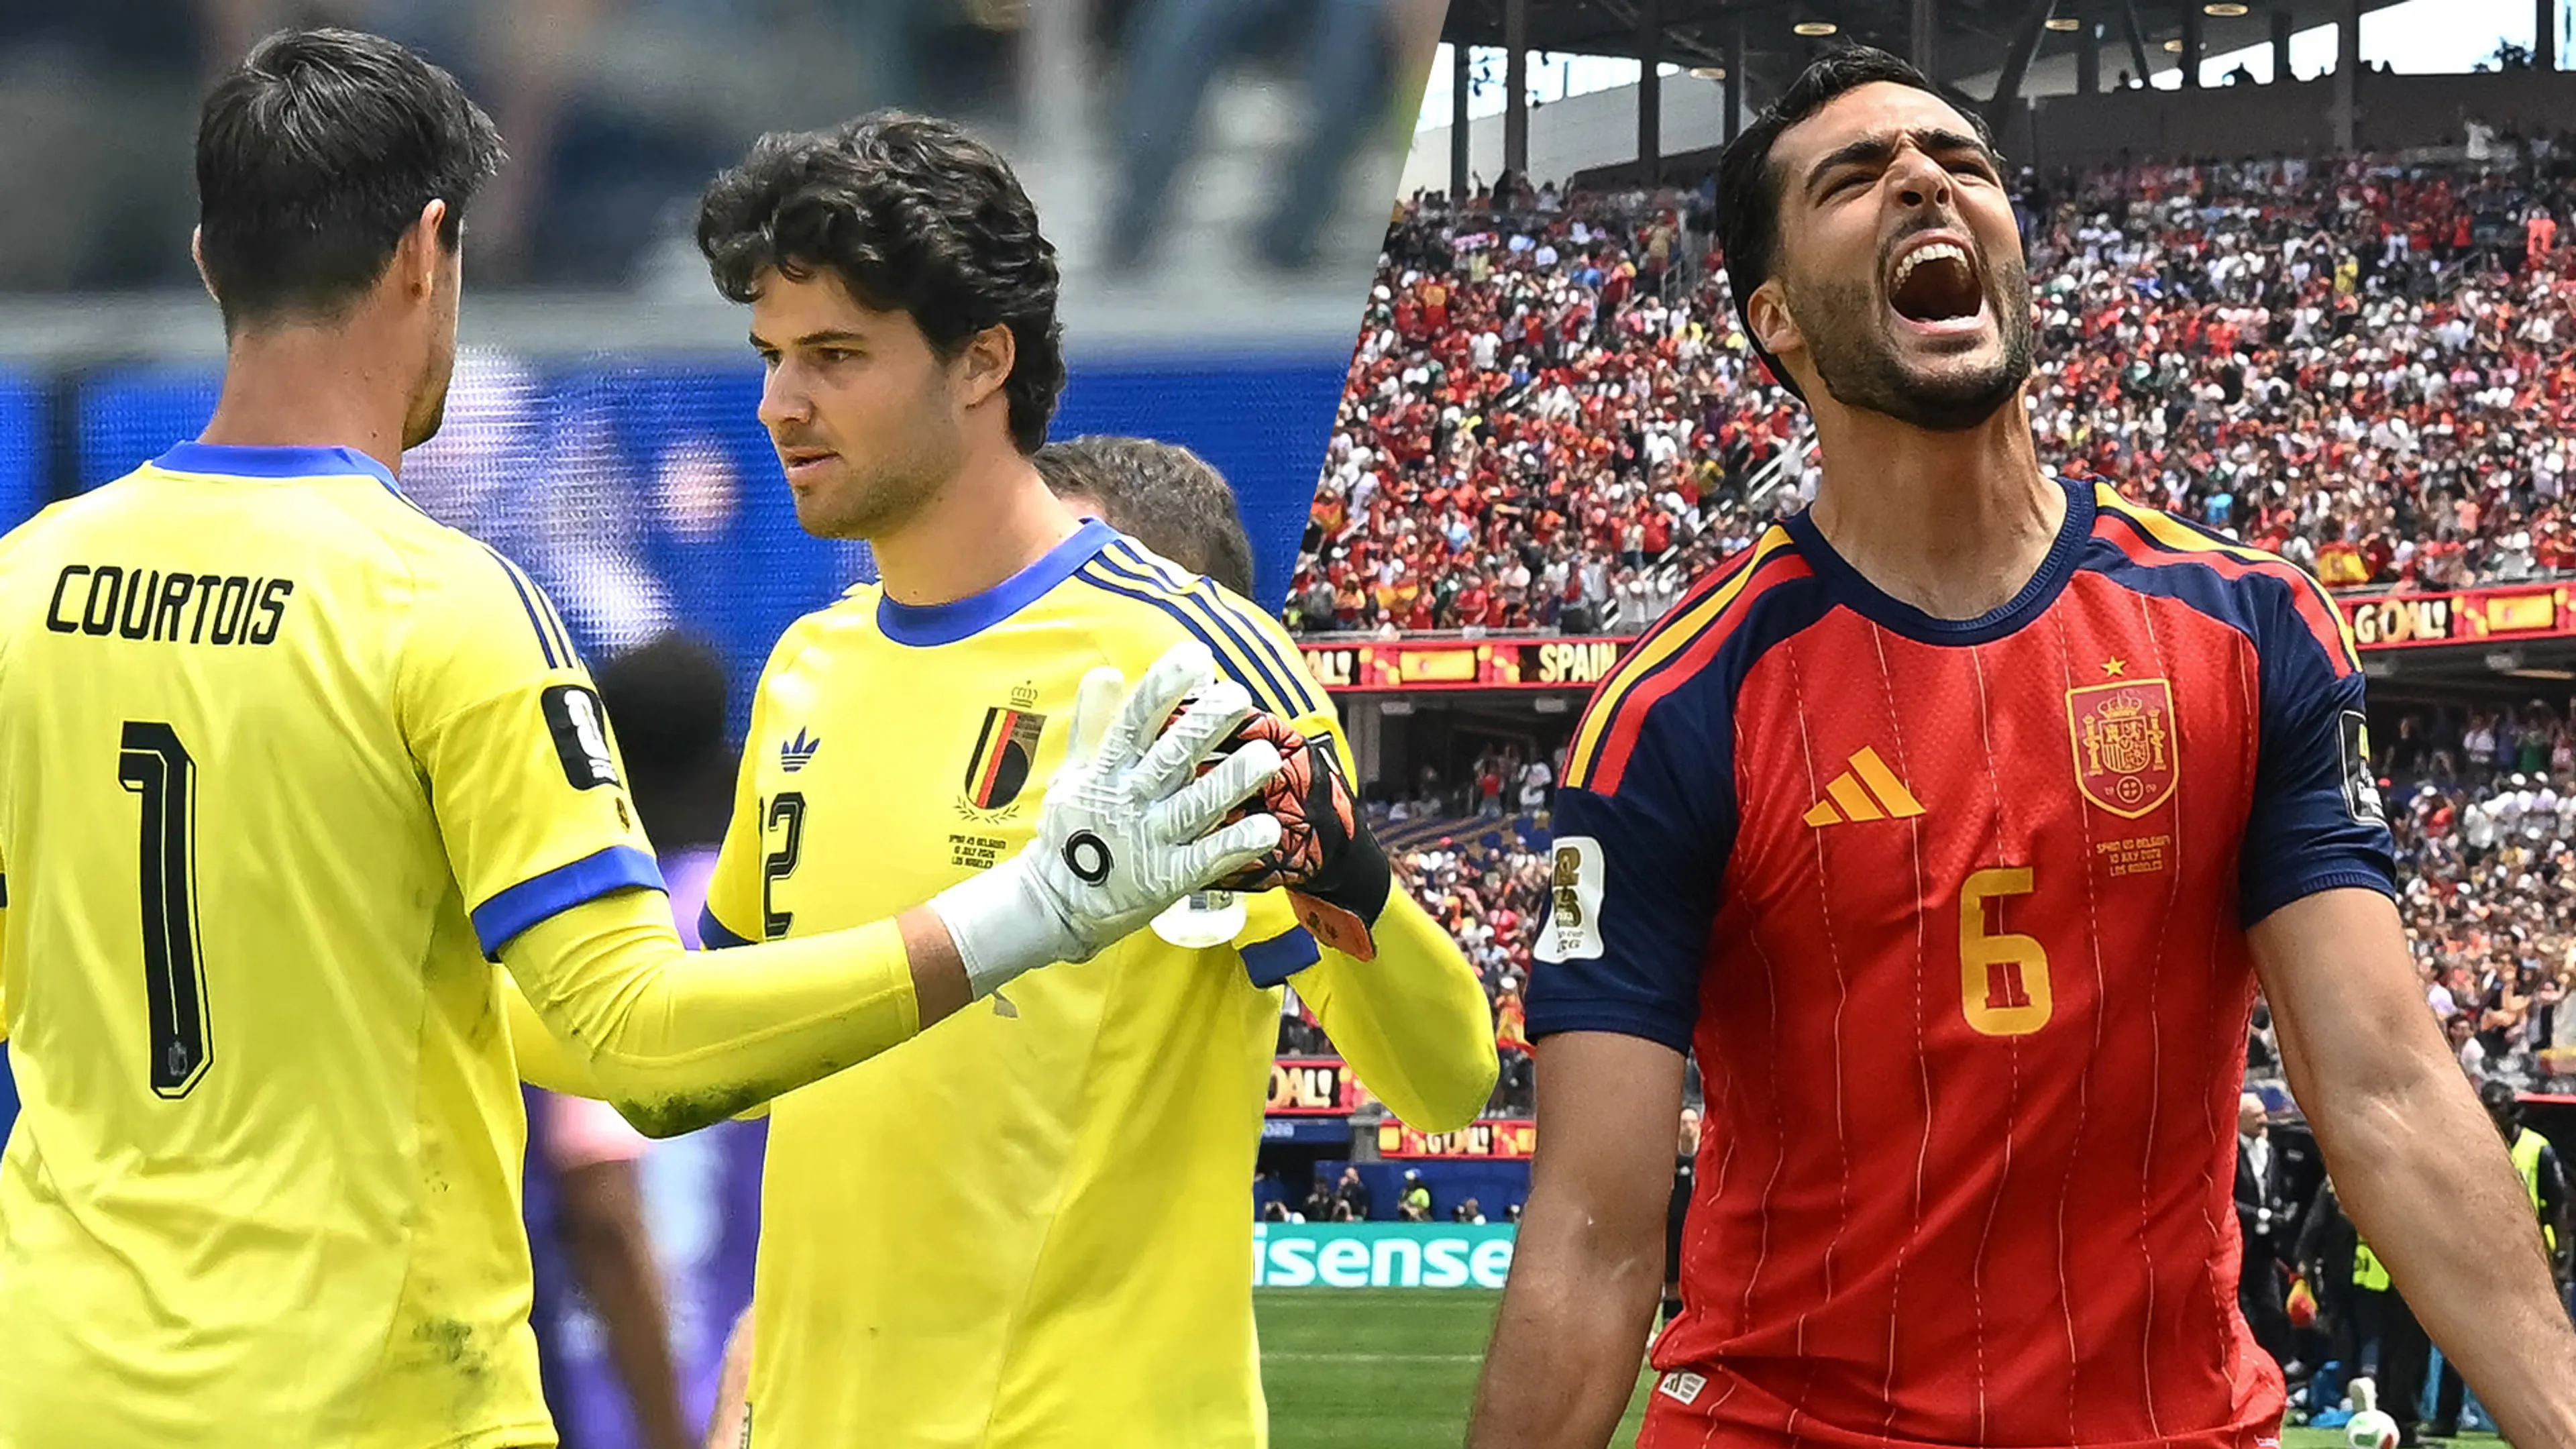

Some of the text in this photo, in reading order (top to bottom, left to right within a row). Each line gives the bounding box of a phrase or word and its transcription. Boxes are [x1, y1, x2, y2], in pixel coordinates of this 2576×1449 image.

[46, 564, 294, 646] COURTOIS
[2355, 599, 2447, 643] GOAL!
[1539, 642, 1617, 683] SPAIN
[759, 791, 807, 943] 2
[118, 720, 214, 1100] 1
[1960, 867, 2053, 1036] 6
[1253, 1224, 1514, 1287] isense
